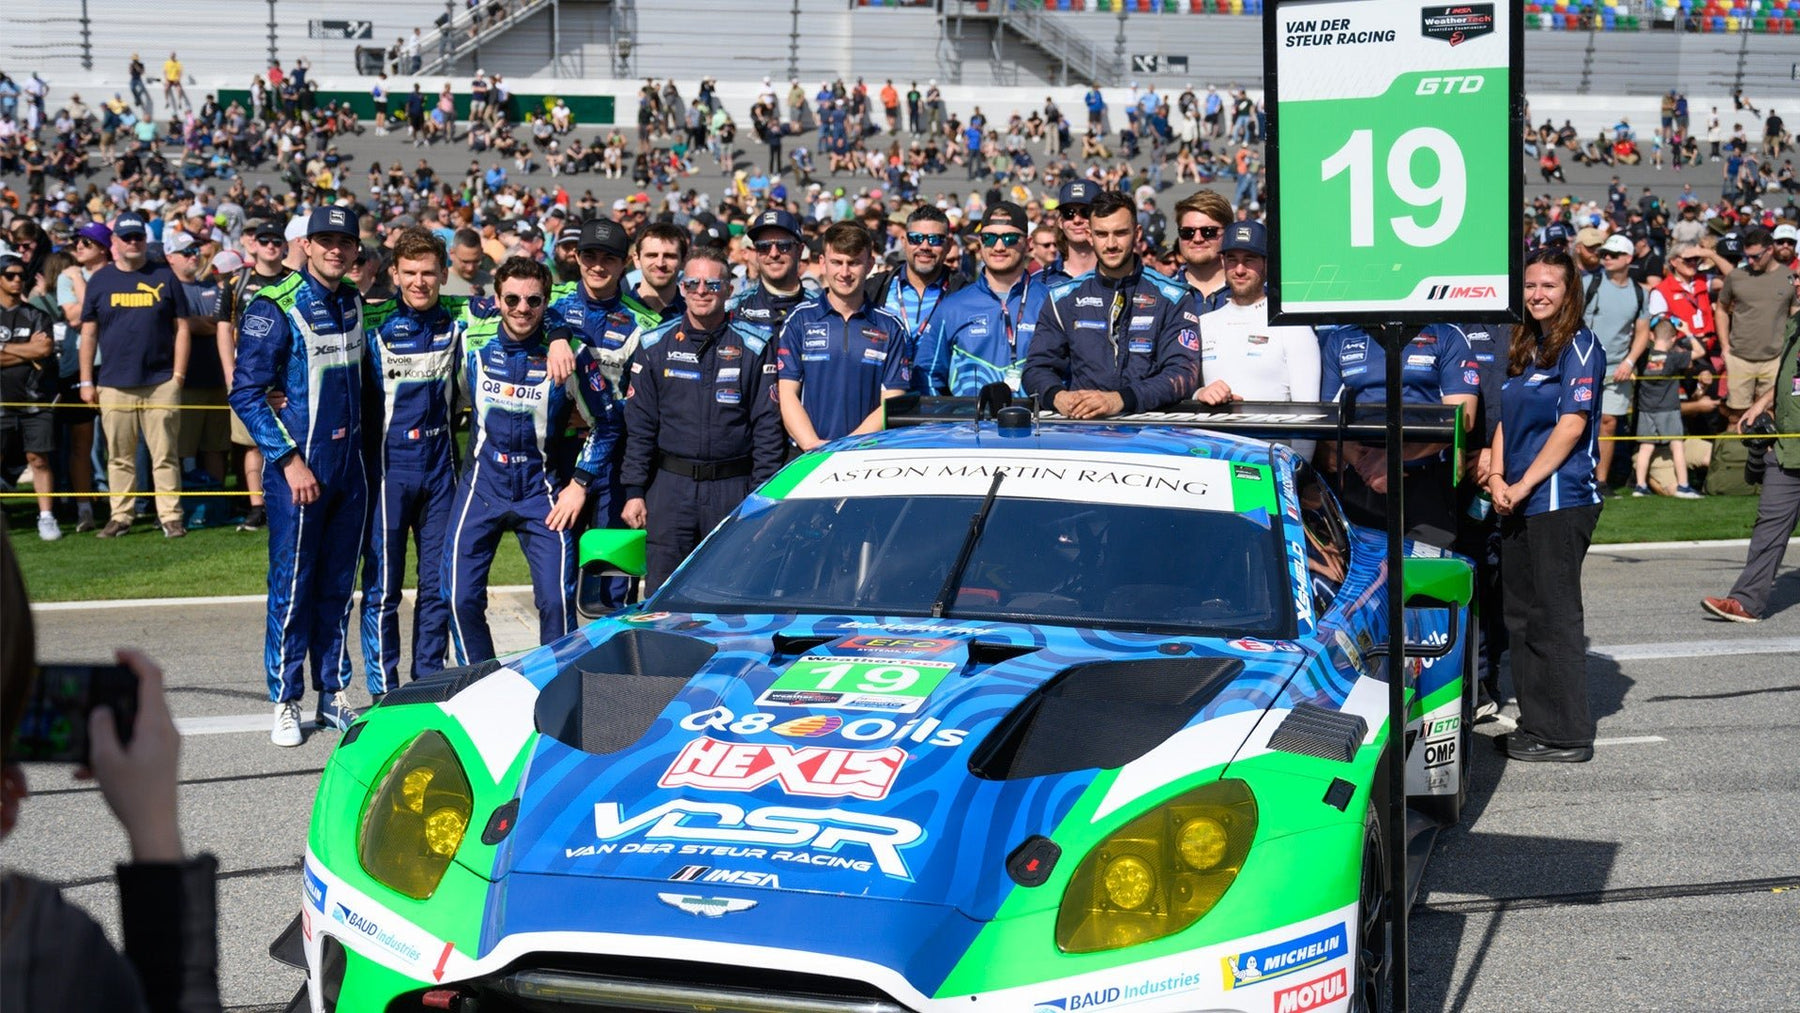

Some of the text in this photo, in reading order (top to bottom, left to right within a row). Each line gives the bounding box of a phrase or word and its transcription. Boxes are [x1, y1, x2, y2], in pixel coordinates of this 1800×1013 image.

[1285, 18, 1350, 34] VAN DER
[1424, 15, 1492, 25] WeatherTech
[1285, 30, 1396, 48] STEUR RACING
[1415, 75, 1485, 95] GTD
[1321, 126, 1467, 248] 19
[110, 293, 153, 308] PUMA
[1449, 286, 1497, 299] IMSA
[482, 380, 543, 400] Q8 Oils
[820, 465, 1208, 495] ASTON MARTIN RACING
[1296, 541, 1315, 630] XSHIELD
[865, 638, 937, 648] EFC
[807, 656, 950, 668] WeatherTech
[809, 663, 921, 693] 19
[679, 705, 971, 748] Q8 Oils
[1434, 717, 1460, 734] GTD
[1424, 741, 1456, 765] OMP
[667, 742, 904, 798] HEXIS
[594, 799, 927, 883] VDSR
[565, 842, 873, 873] VAN DER STEUR RACING
[702, 868, 780, 888] IMSA
[348, 912, 422, 961] BAUD Industries
[1263, 935, 1340, 971] MICHELIN
[1070, 972, 1200, 1011] BAUD Industries
[1277, 973, 1345, 1013] MOTUL
